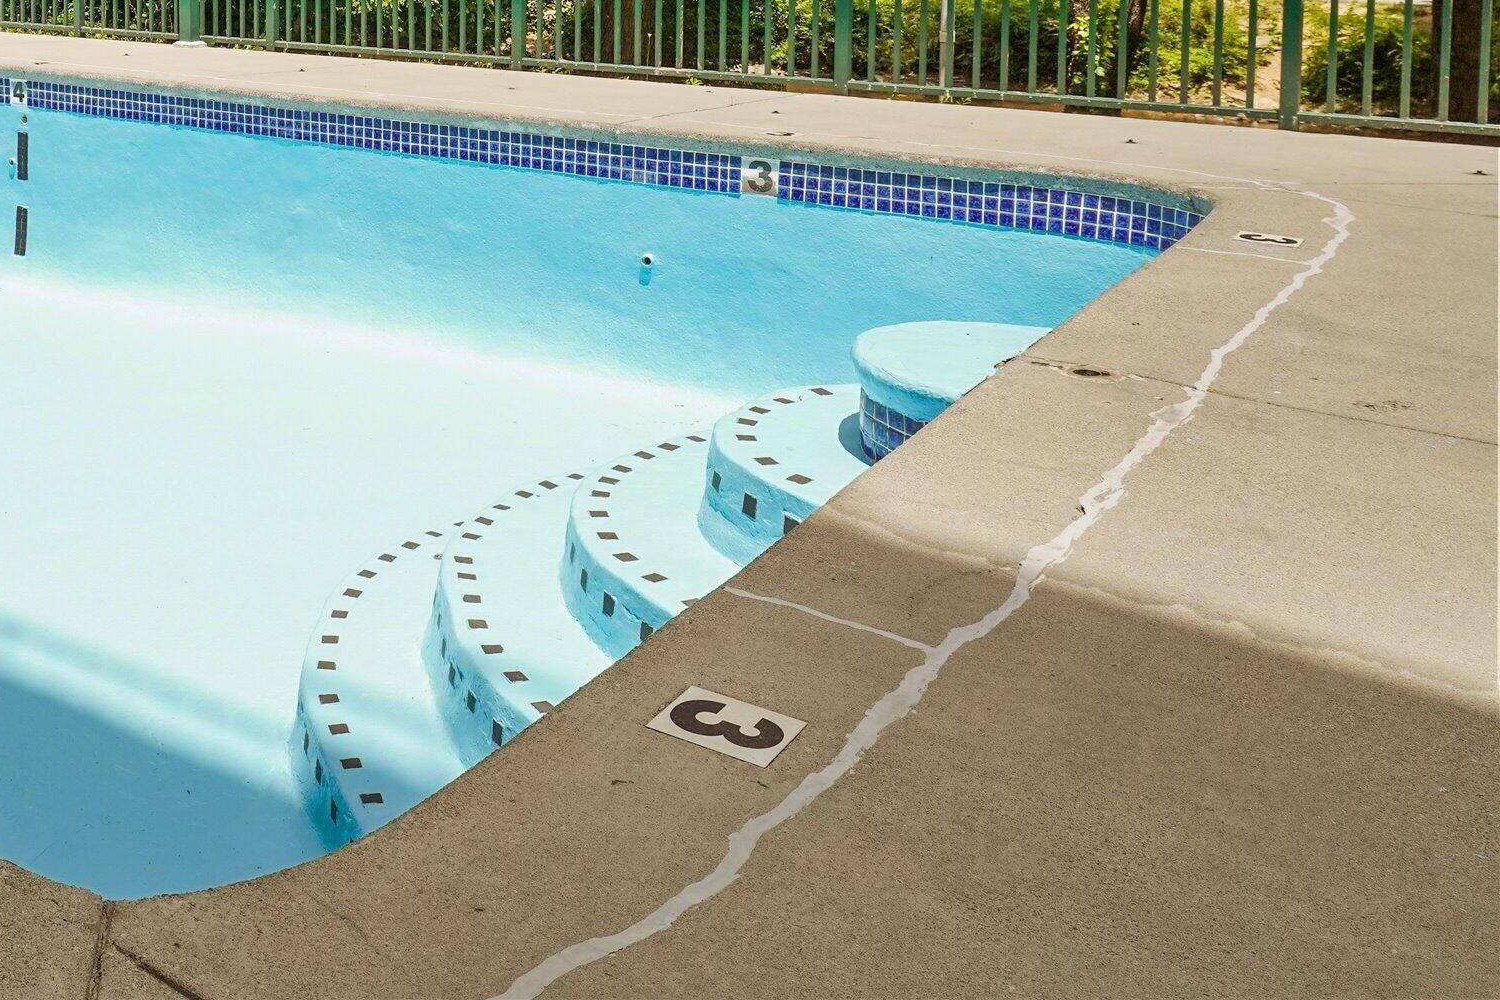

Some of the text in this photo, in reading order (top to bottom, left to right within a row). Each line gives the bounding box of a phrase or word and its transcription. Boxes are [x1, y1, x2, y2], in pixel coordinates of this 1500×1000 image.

[13, 81, 25, 102] 4
[747, 160, 773, 192] 3
[1239, 233, 1298, 245] 3
[668, 698, 784, 751] 3
